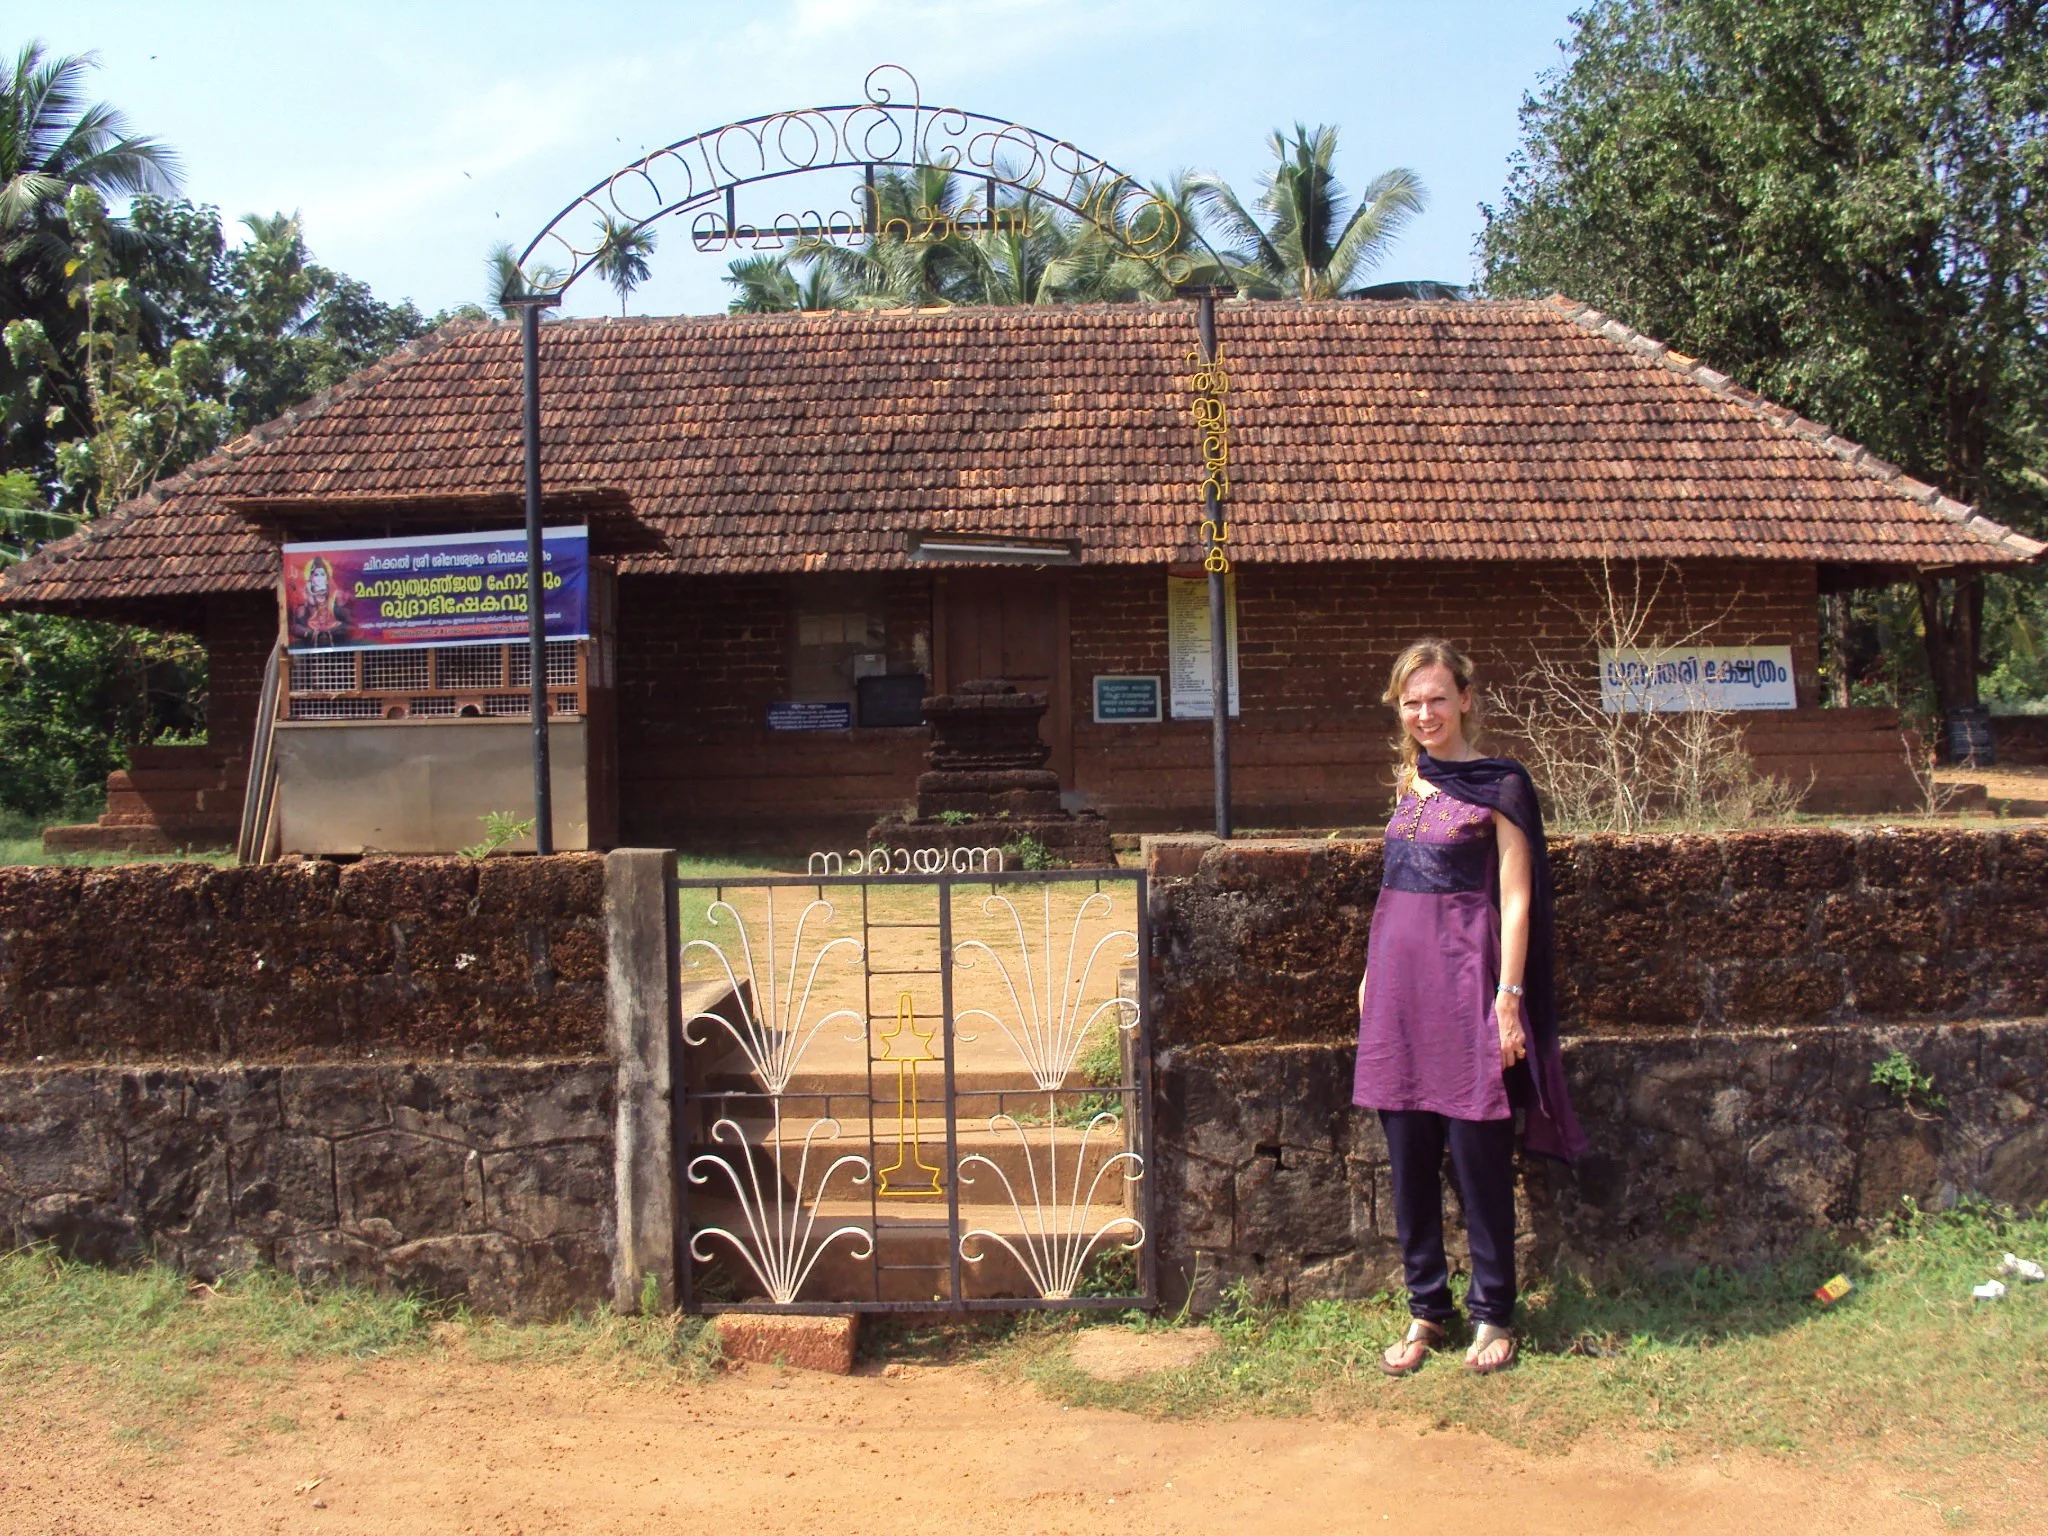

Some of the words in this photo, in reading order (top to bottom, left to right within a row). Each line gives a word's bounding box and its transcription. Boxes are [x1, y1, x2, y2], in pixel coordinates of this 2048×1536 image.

[922, 107, 1193, 285] ക്ഷേത്രം
[363, 555, 410, 571] ചിറക്കൽ
[413, 554, 430, 572] ശ്രീ
[381, 593, 529, 619] രുദ്രാഭിഷേകവു
[808, 847, 1004, 876] നാരായണ
